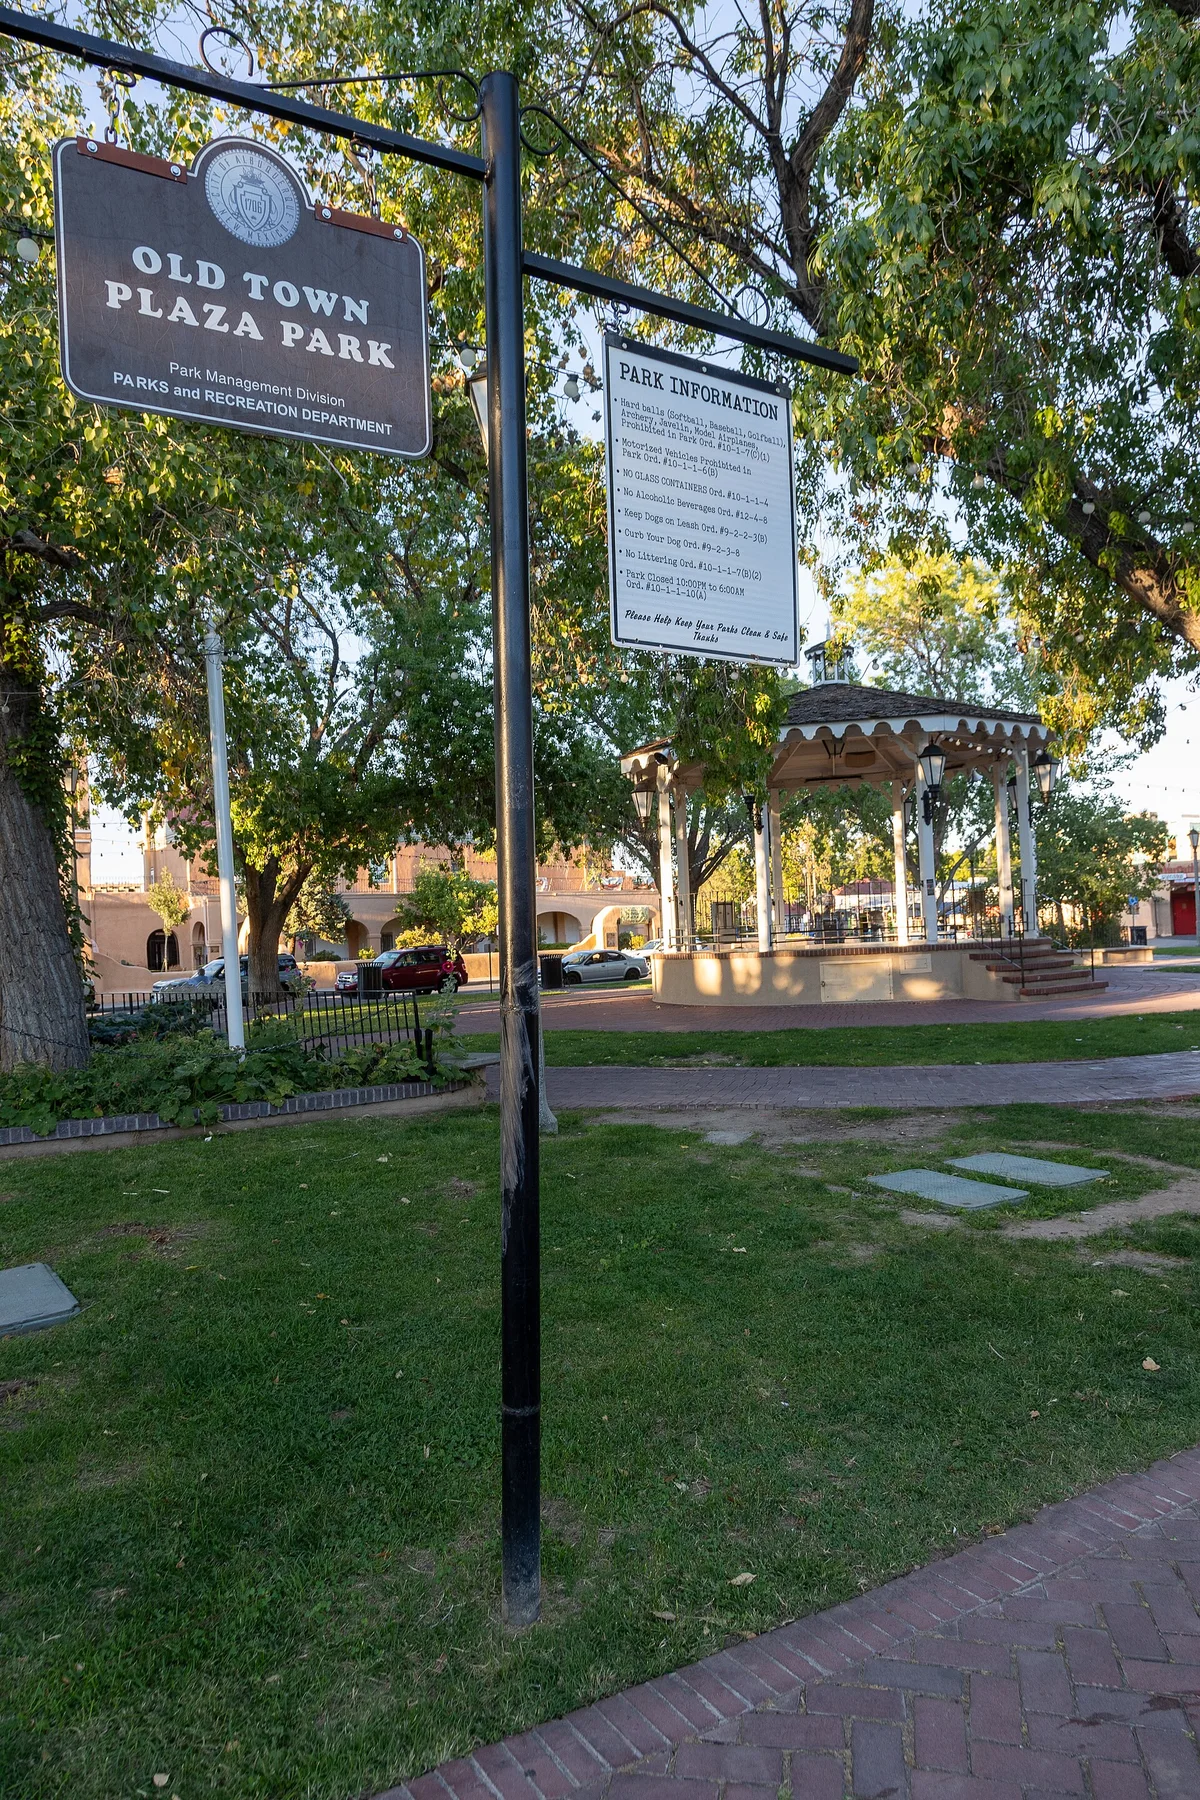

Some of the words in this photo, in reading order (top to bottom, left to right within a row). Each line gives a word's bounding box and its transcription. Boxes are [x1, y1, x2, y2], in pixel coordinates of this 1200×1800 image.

[211, 171, 221, 198] CITY
[219, 158, 231, 171] OF
[235, 155, 295, 219] ALBUQUERQUE
[244, 198, 263, 214] 1706
[218, 209, 241, 232] NEW
[247, 224, 290, 242] MEXICO
[131, 245, 226, 291] OLD
[242, 271, 370, 326] TOWN
[104, 279, 264, 342] PLAZA
[280, 320, 396, 370] PARK
[169, 361, 202, 380] Park
[206, 369, 293, 399] Management
[296, 386, 346, 408] Division
[620, 361, 664, 390] PARK
[670, 376, 778, 421] INFORMATION
[113, 371, 170, 395] PARKS
[173, 385, 201, 401] and
[204, 389, 298, 420] RECREATION
[302, 407, 393, 436] DEPARTMENT
[620, 397, 640, 410] Hard
[642, 403, 665, 416] balls
[667, 409, 708, 429] (Softball,
[710, 420, 746, 438] Baseball,
[621, 408, 657, 426] Archery,
[659, 418, 693, 435] Javelin,
[695, 426, 715, 439] Model
[719, 433, 759, 450] Airplanes,
[621, 418, 665, 437] Prohibited
[668, 429, 677, 440] in
[679, 432, 697, 444] Park
[699, 438, 716, 449] Ord.
[622, 437, 662, 454] Motorized
[665, 447, 698, 463] Vehicles
[700, 456, 741, 473] Prohibited
[743, 465, 752, 475] in
[622, 447, 642, 460] Park
[644, 452, 661, 464] Ord.
[663, 457, 718, 478] #10-1-1-6(B)
[623, 468, 633, 478] NO
[635, 471, 660, 484] GLASS
[661, 476, 708, 495] CONTAINERS
[709, 487, 726, 498] Ord.
[727, 490, 769, 507] #10-1-1-4
[623, 486, 634, 497] No
[636, 490, 675, 506] Alcoholic
[677, 498, 716, 514] Beverages
[717, 506, 734, 517] Ord.
[735, 510, 768, 524] #12-4-8
[624, 507, 643, 521] Keep
[645, 511, 664, 524] Dogs
[665, 517, 675, 526] on
[677, 518, 700, 530] Leash
[701, 523, 718, 534] Ord.
[720, 526, 768, 544] #9-2-2-3(B)
[624, 528, 644, 540] Curb
[646, 532, 665, 543] Your
[667, 536, 681, 548] Dog
[683, 539, 700, 550] Ord.
[702, 542, 740, 557] #9-2-3-8
[625, 548, 636, 559] No
[638, 550, 678, 568] Littering
[680, 558, 697, 569] Ord.
[698, 561, 762, 581] #10-1-1-7(B)(2)
[626, 568, 645, 580] Park
[647, 572, 674, 585] Closed
[676, 577, 707, 590] 10:00PM
[708, 583, 717, 592] to
[719, 584, 745, 596] 6:00AM
[626, 579, 644, 590] Ord.
[646, 582, 707, 601] #10-1-1-10(A)
[625, 609, 651, 622] Please
[653, 613, 672, 626] Help
[674, 616, 693, 629] Keep
[695, 620, 714, 630] Your
[716, 623, 738, 634] Parks
[740, 626, 761, 637] Clean
[764, 630, 770, 638] &
[772, 630, 788, 642] Safe
[693, 631, 719, 643] Thanks
